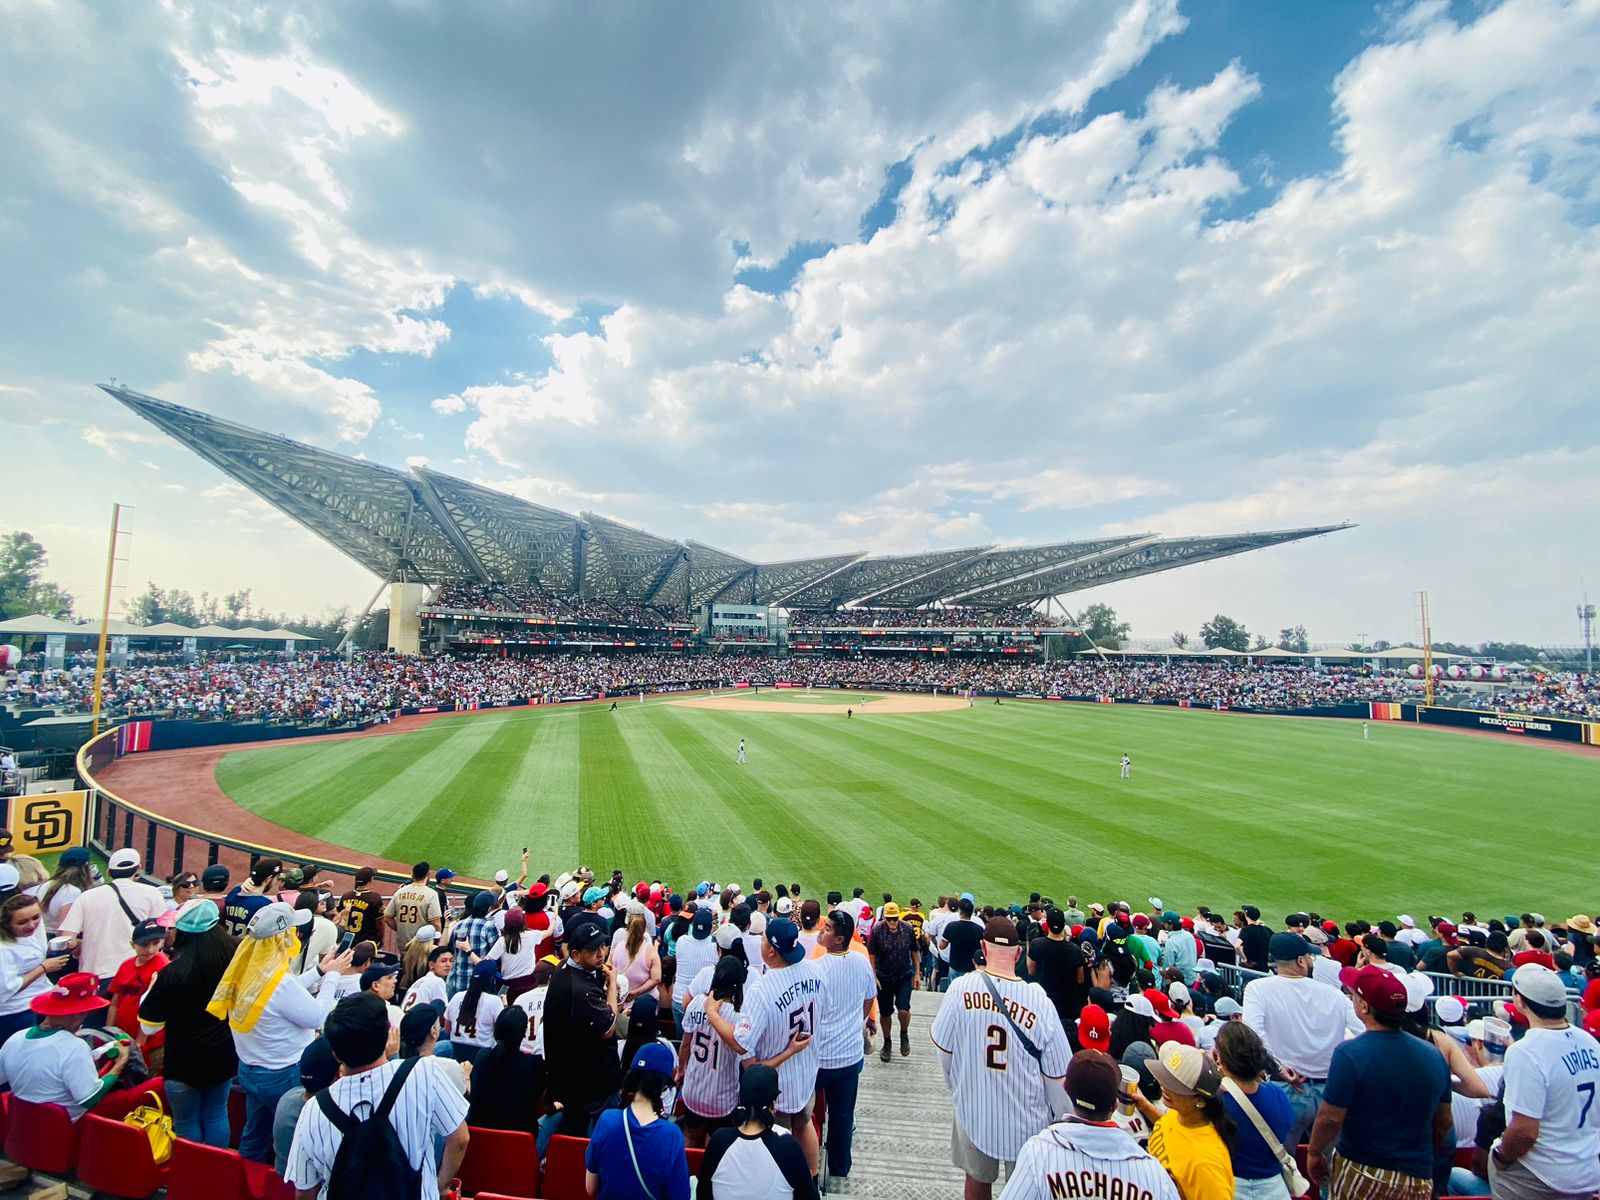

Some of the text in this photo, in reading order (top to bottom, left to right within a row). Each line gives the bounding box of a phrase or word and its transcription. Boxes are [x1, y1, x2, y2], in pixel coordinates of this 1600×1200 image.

[1479, 717, 1508, 727] MEXICO
[1508, 720, 1525, 728] CITY
[1525, 722, 1552, 732] SERIES
[24, 800, 73, 849] SD
[226, 905, 249, 920] YOUNG
[399, 905, 418, 923] 23
[775, 979, 821, 1013] HOFFMAN
[690, 1011, 707, 1025] HOF
[789, 1001, 814, 1040] 51
[694, 1031, 719, 1070] 51
[986, 1024, 1007, 1070] 2
[1577, 1081, 1595, 1128] 7
